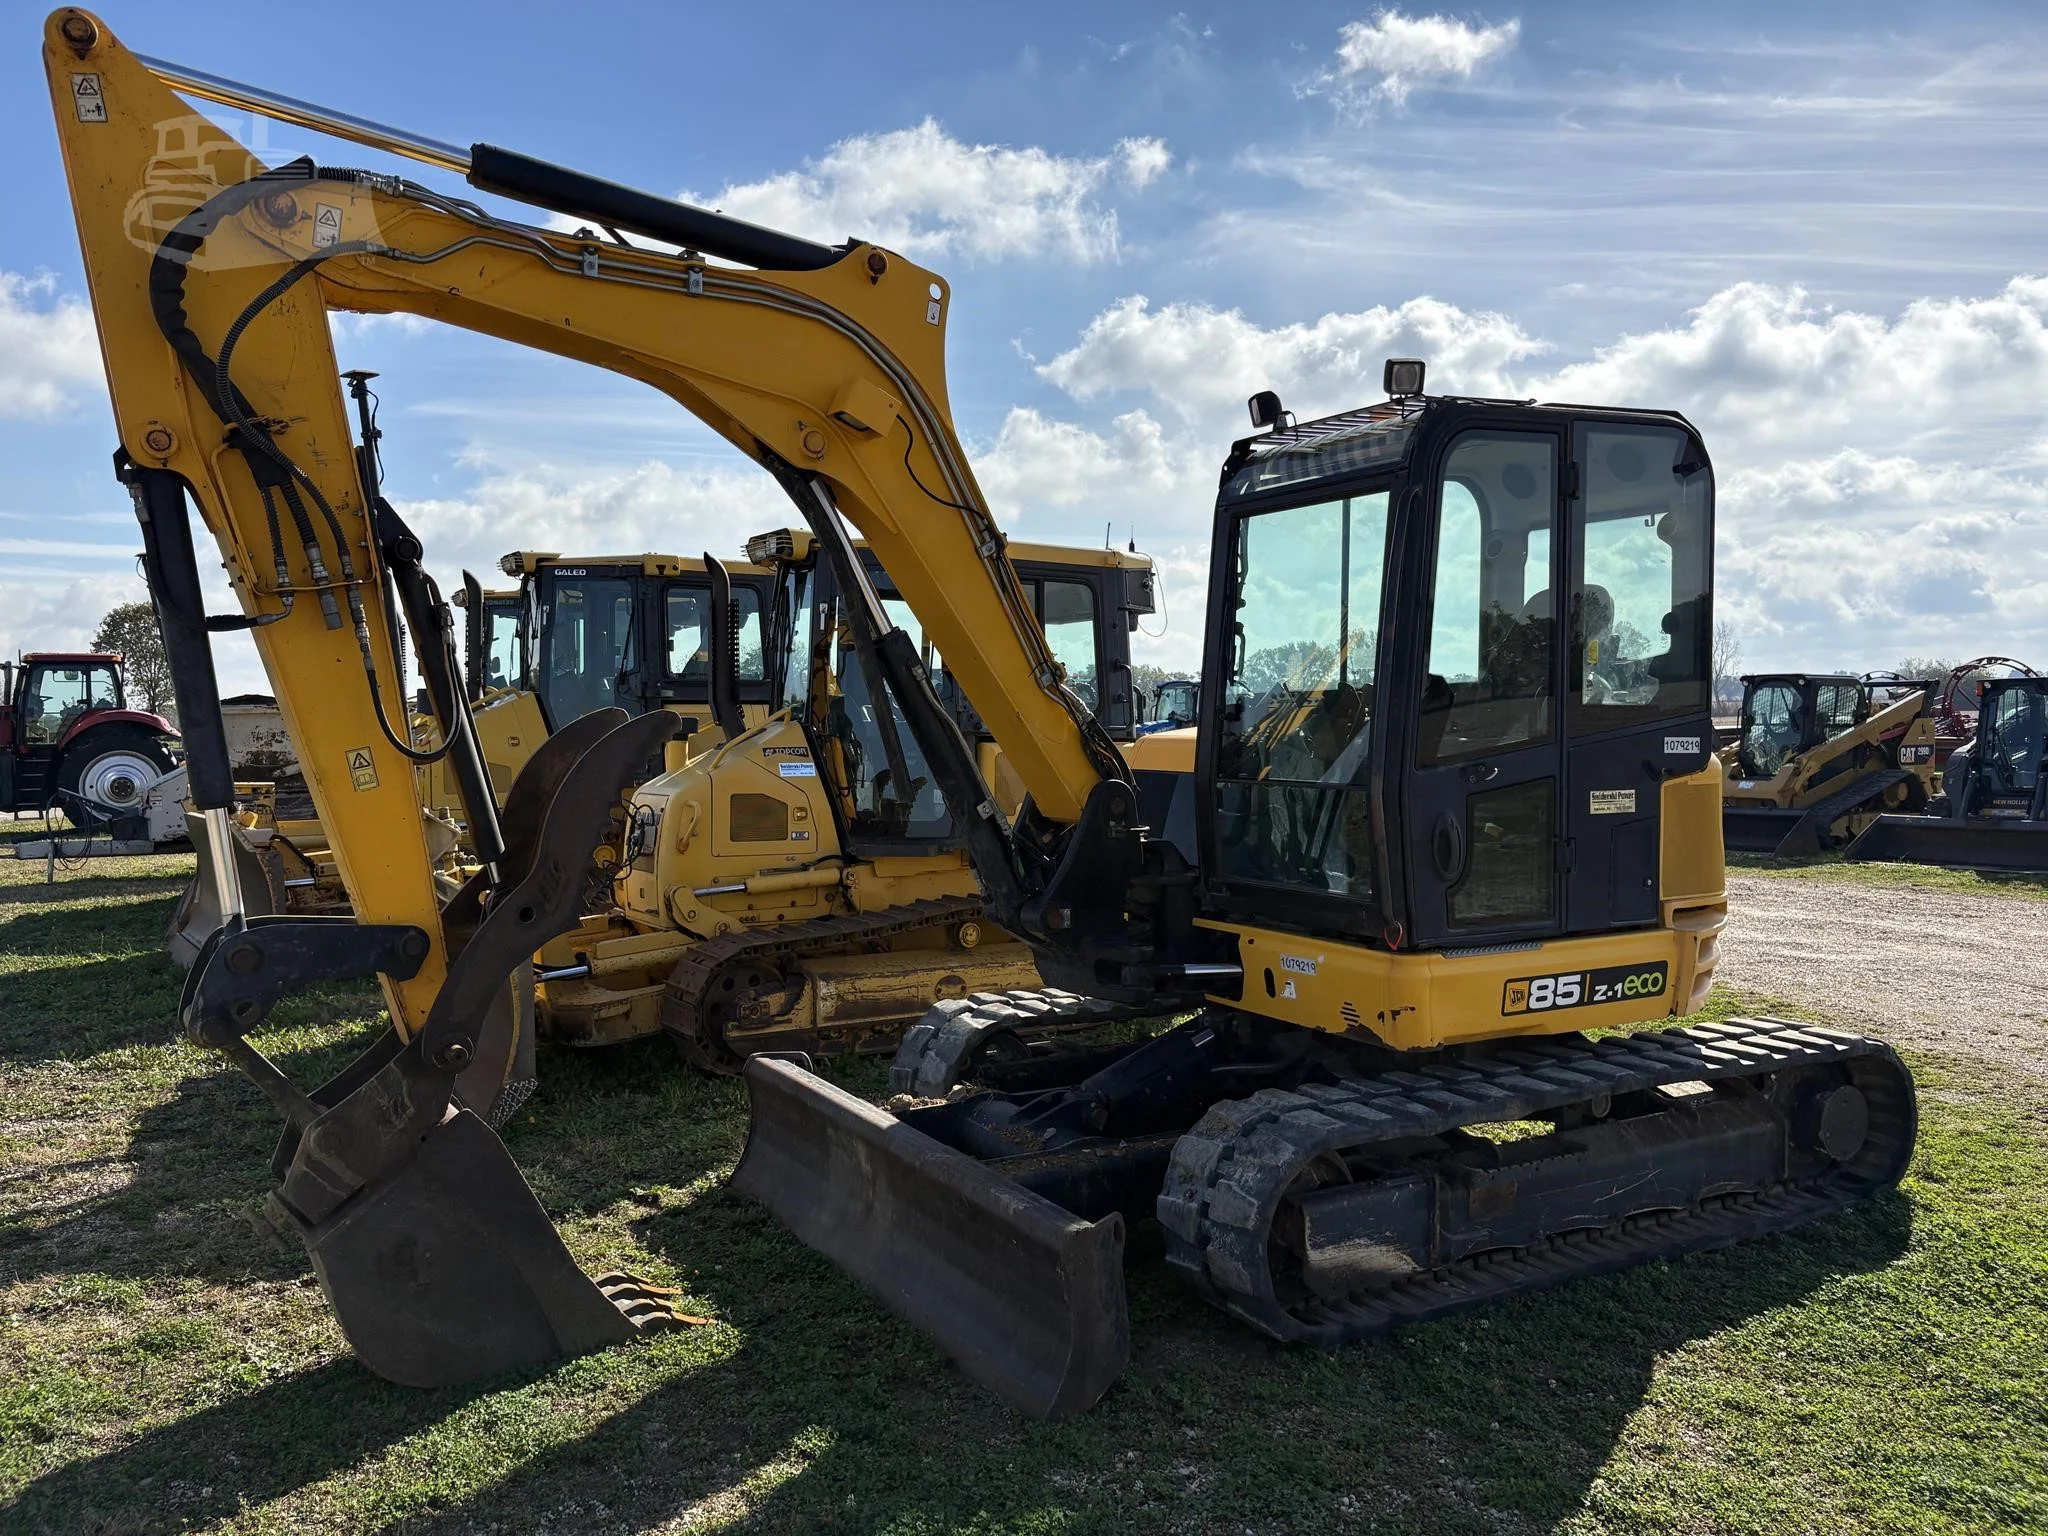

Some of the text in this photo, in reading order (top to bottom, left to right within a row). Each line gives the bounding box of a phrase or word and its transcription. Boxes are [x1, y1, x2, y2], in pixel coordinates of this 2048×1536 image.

[554, 568, 587, 576] GALEO
[775, 747, 808, 756] TOPCON
[1664, 740, 1700, 751] 1079219
[1900, 747, 1916, 763] CAT
[1280, 956, 1317, 974] 1079219
[1510, 988, 1526, 1006] JCB
[1528, 974, 1582, 1010] 85
